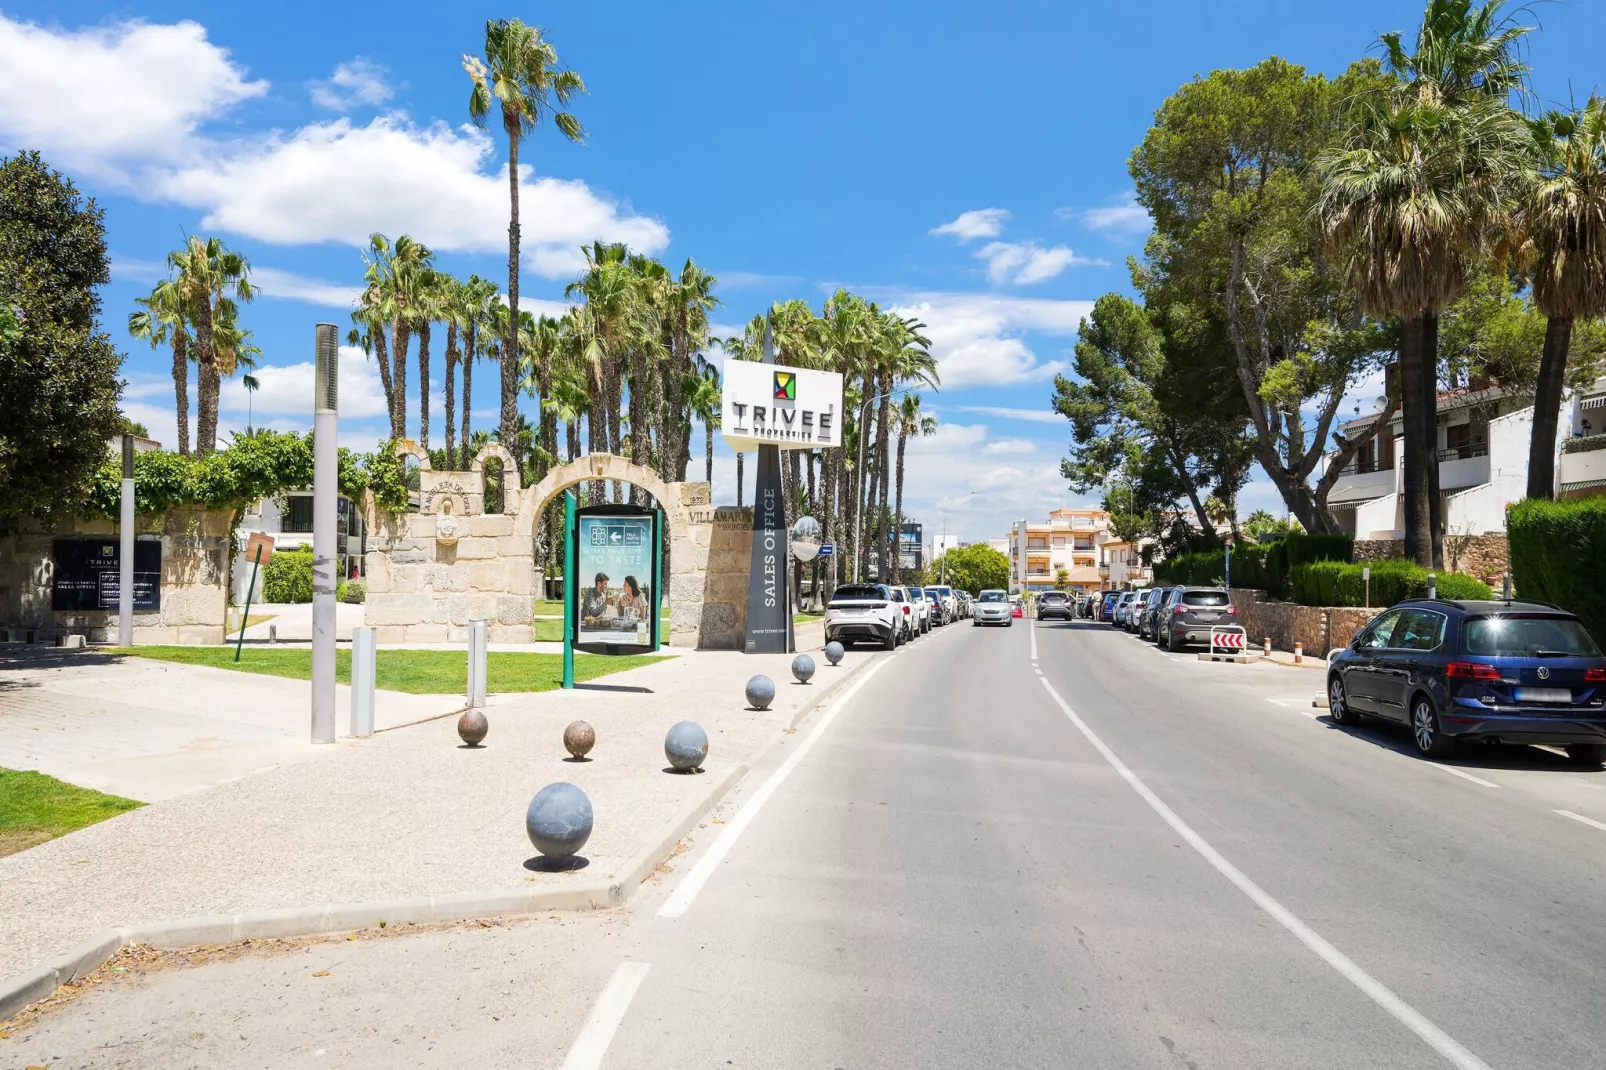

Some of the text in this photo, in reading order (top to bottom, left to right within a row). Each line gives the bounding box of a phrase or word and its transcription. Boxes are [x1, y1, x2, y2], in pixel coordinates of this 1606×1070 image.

[733, 401, 832, 428] TRIVEE
[754, 427, 812, 439] PROPERTIES
[764, 488, 776, 608] SALES OFFICE
[591, 555, 642, 565] TO TASTE
